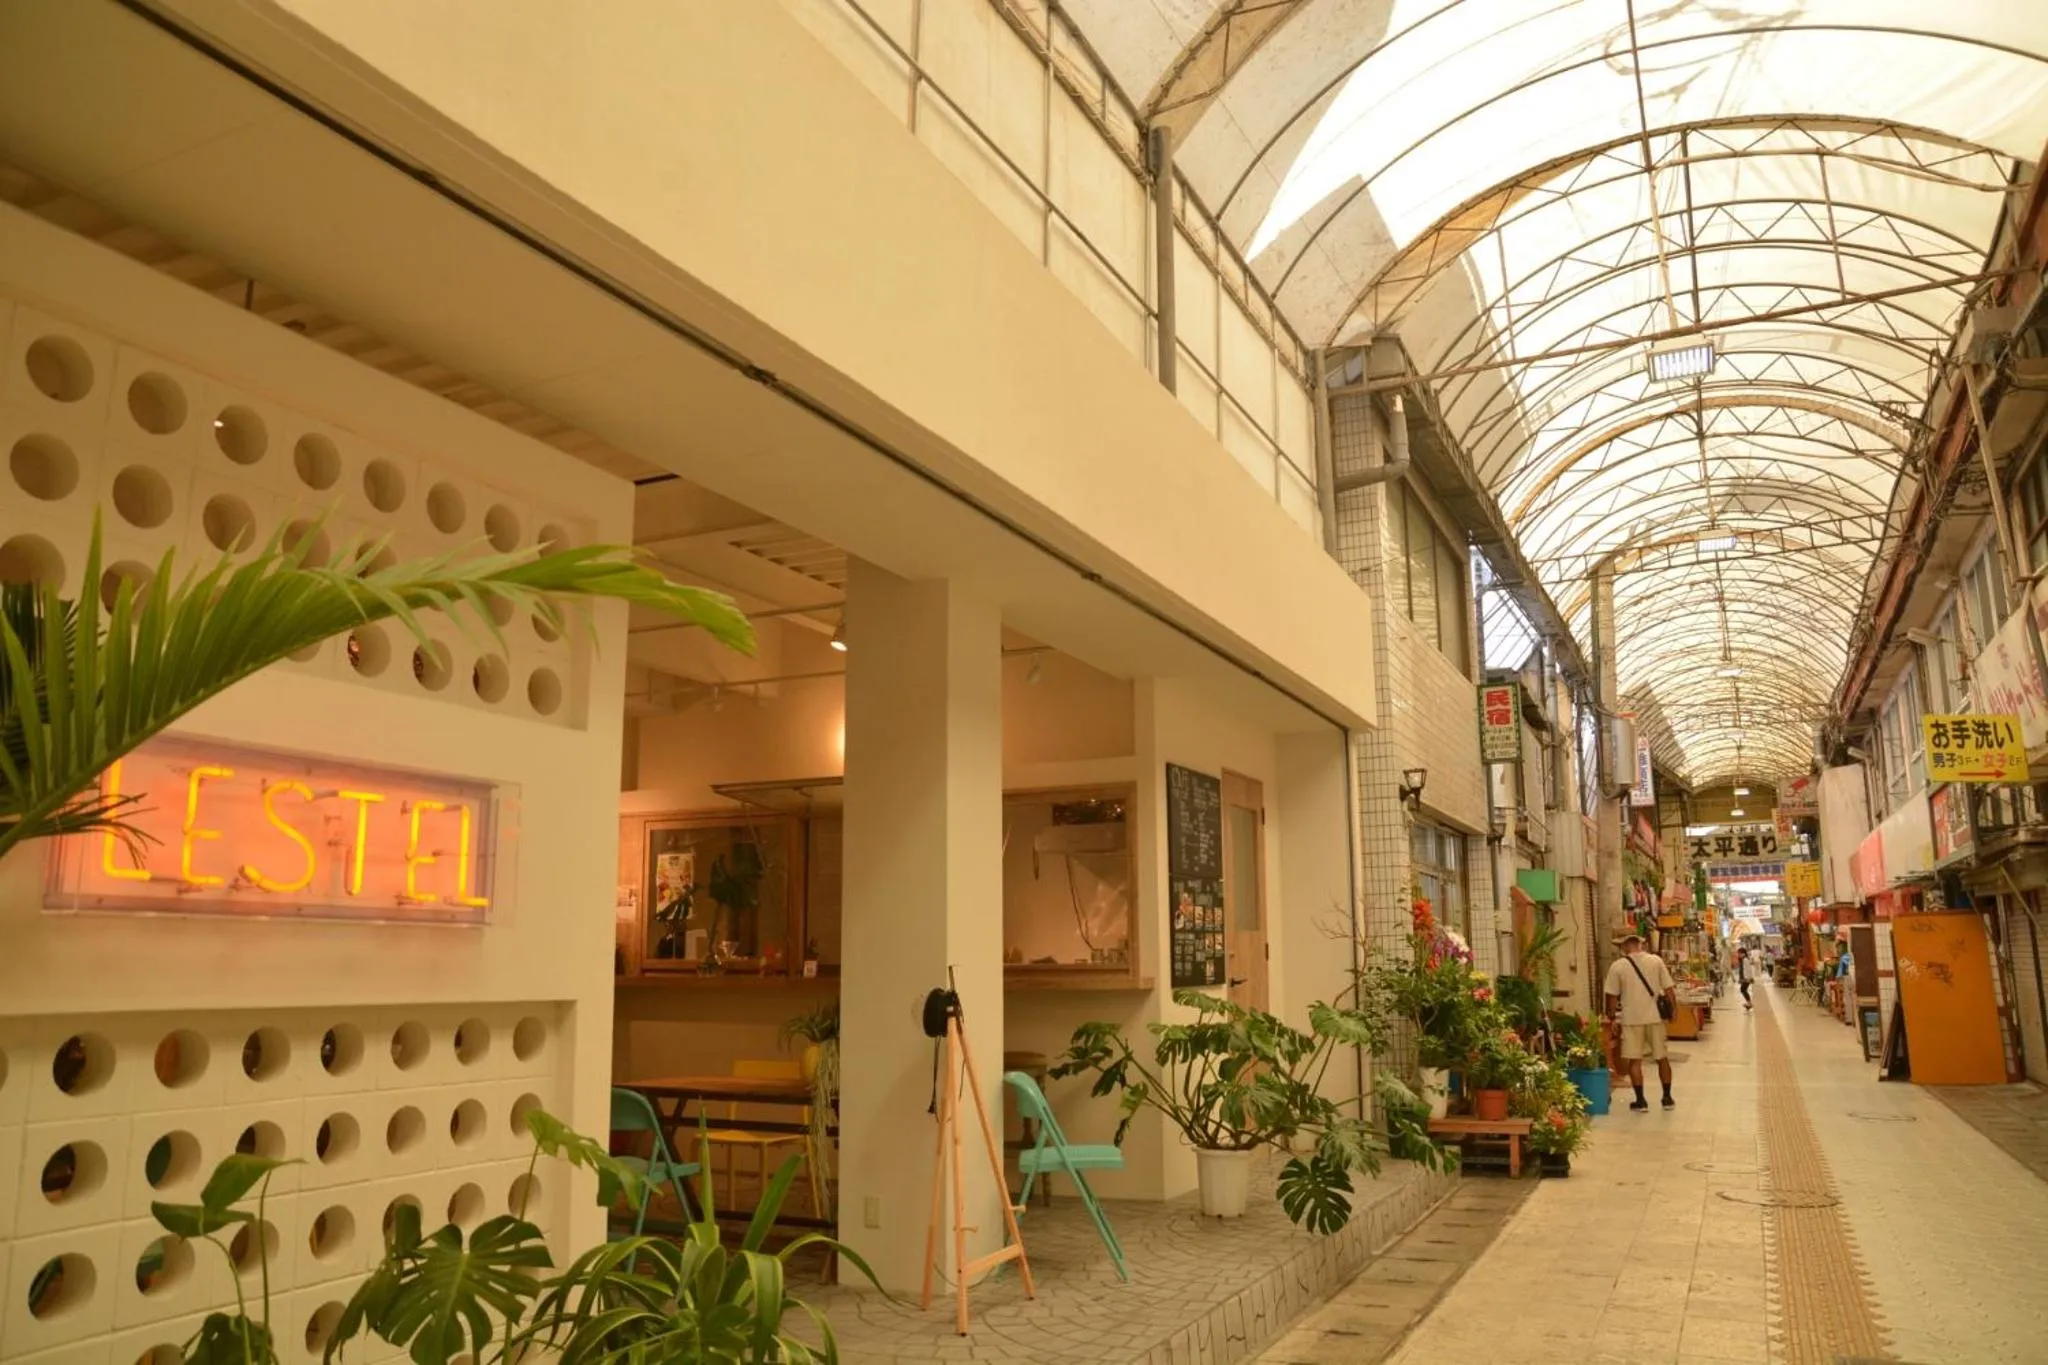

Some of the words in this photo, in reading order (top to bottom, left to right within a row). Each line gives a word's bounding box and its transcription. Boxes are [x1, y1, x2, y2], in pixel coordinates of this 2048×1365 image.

[1486, 690, 1511, 726] 民宿
[1930, 719, 2015, 749] お手洗い
[103, 757, 489, 906] LESTEL
[1690, 835, 1778, 859] 太平通り
